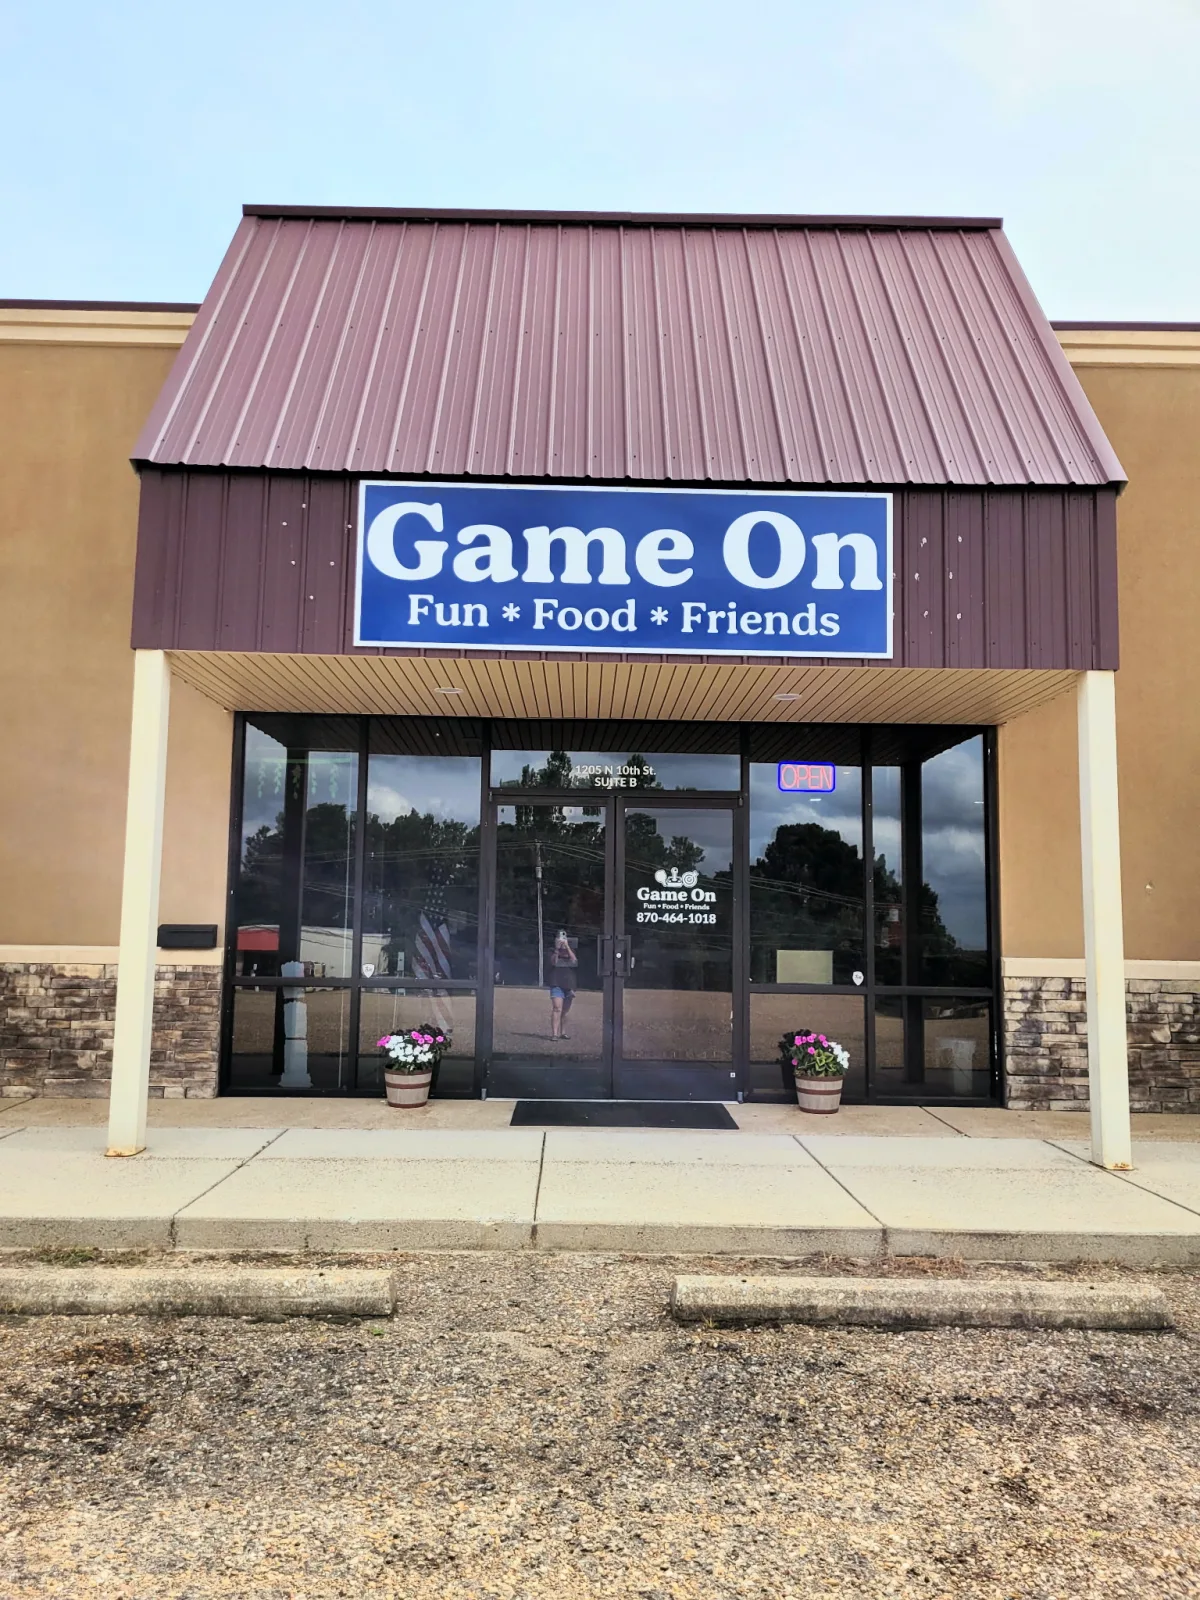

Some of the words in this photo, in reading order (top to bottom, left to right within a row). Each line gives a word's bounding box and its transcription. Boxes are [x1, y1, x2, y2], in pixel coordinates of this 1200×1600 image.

[366, 501, 695, 588] Game
[722, 510, 884, 592] On
[406, 593, 490, 628] Fun
[532, 599, 638, 633] Food
[680, 602, 841, 637] Friends
[575, 765, 602, 775] 1205
[604, 765, 613, 775] N
[616, 765, 641, 775] 10th
[642, 766, 657, 775] St.
[594, 777, 627, 788] SUITE
[629, 777, 638, 788] B
[781, 764, 833, 790] OPEN
[636, 887, 689, 902] Game
[690, 888, 717, 902] On
[684, 903, 710, 911] Friends
[636, 912, 717, 924] 870-464-1018
